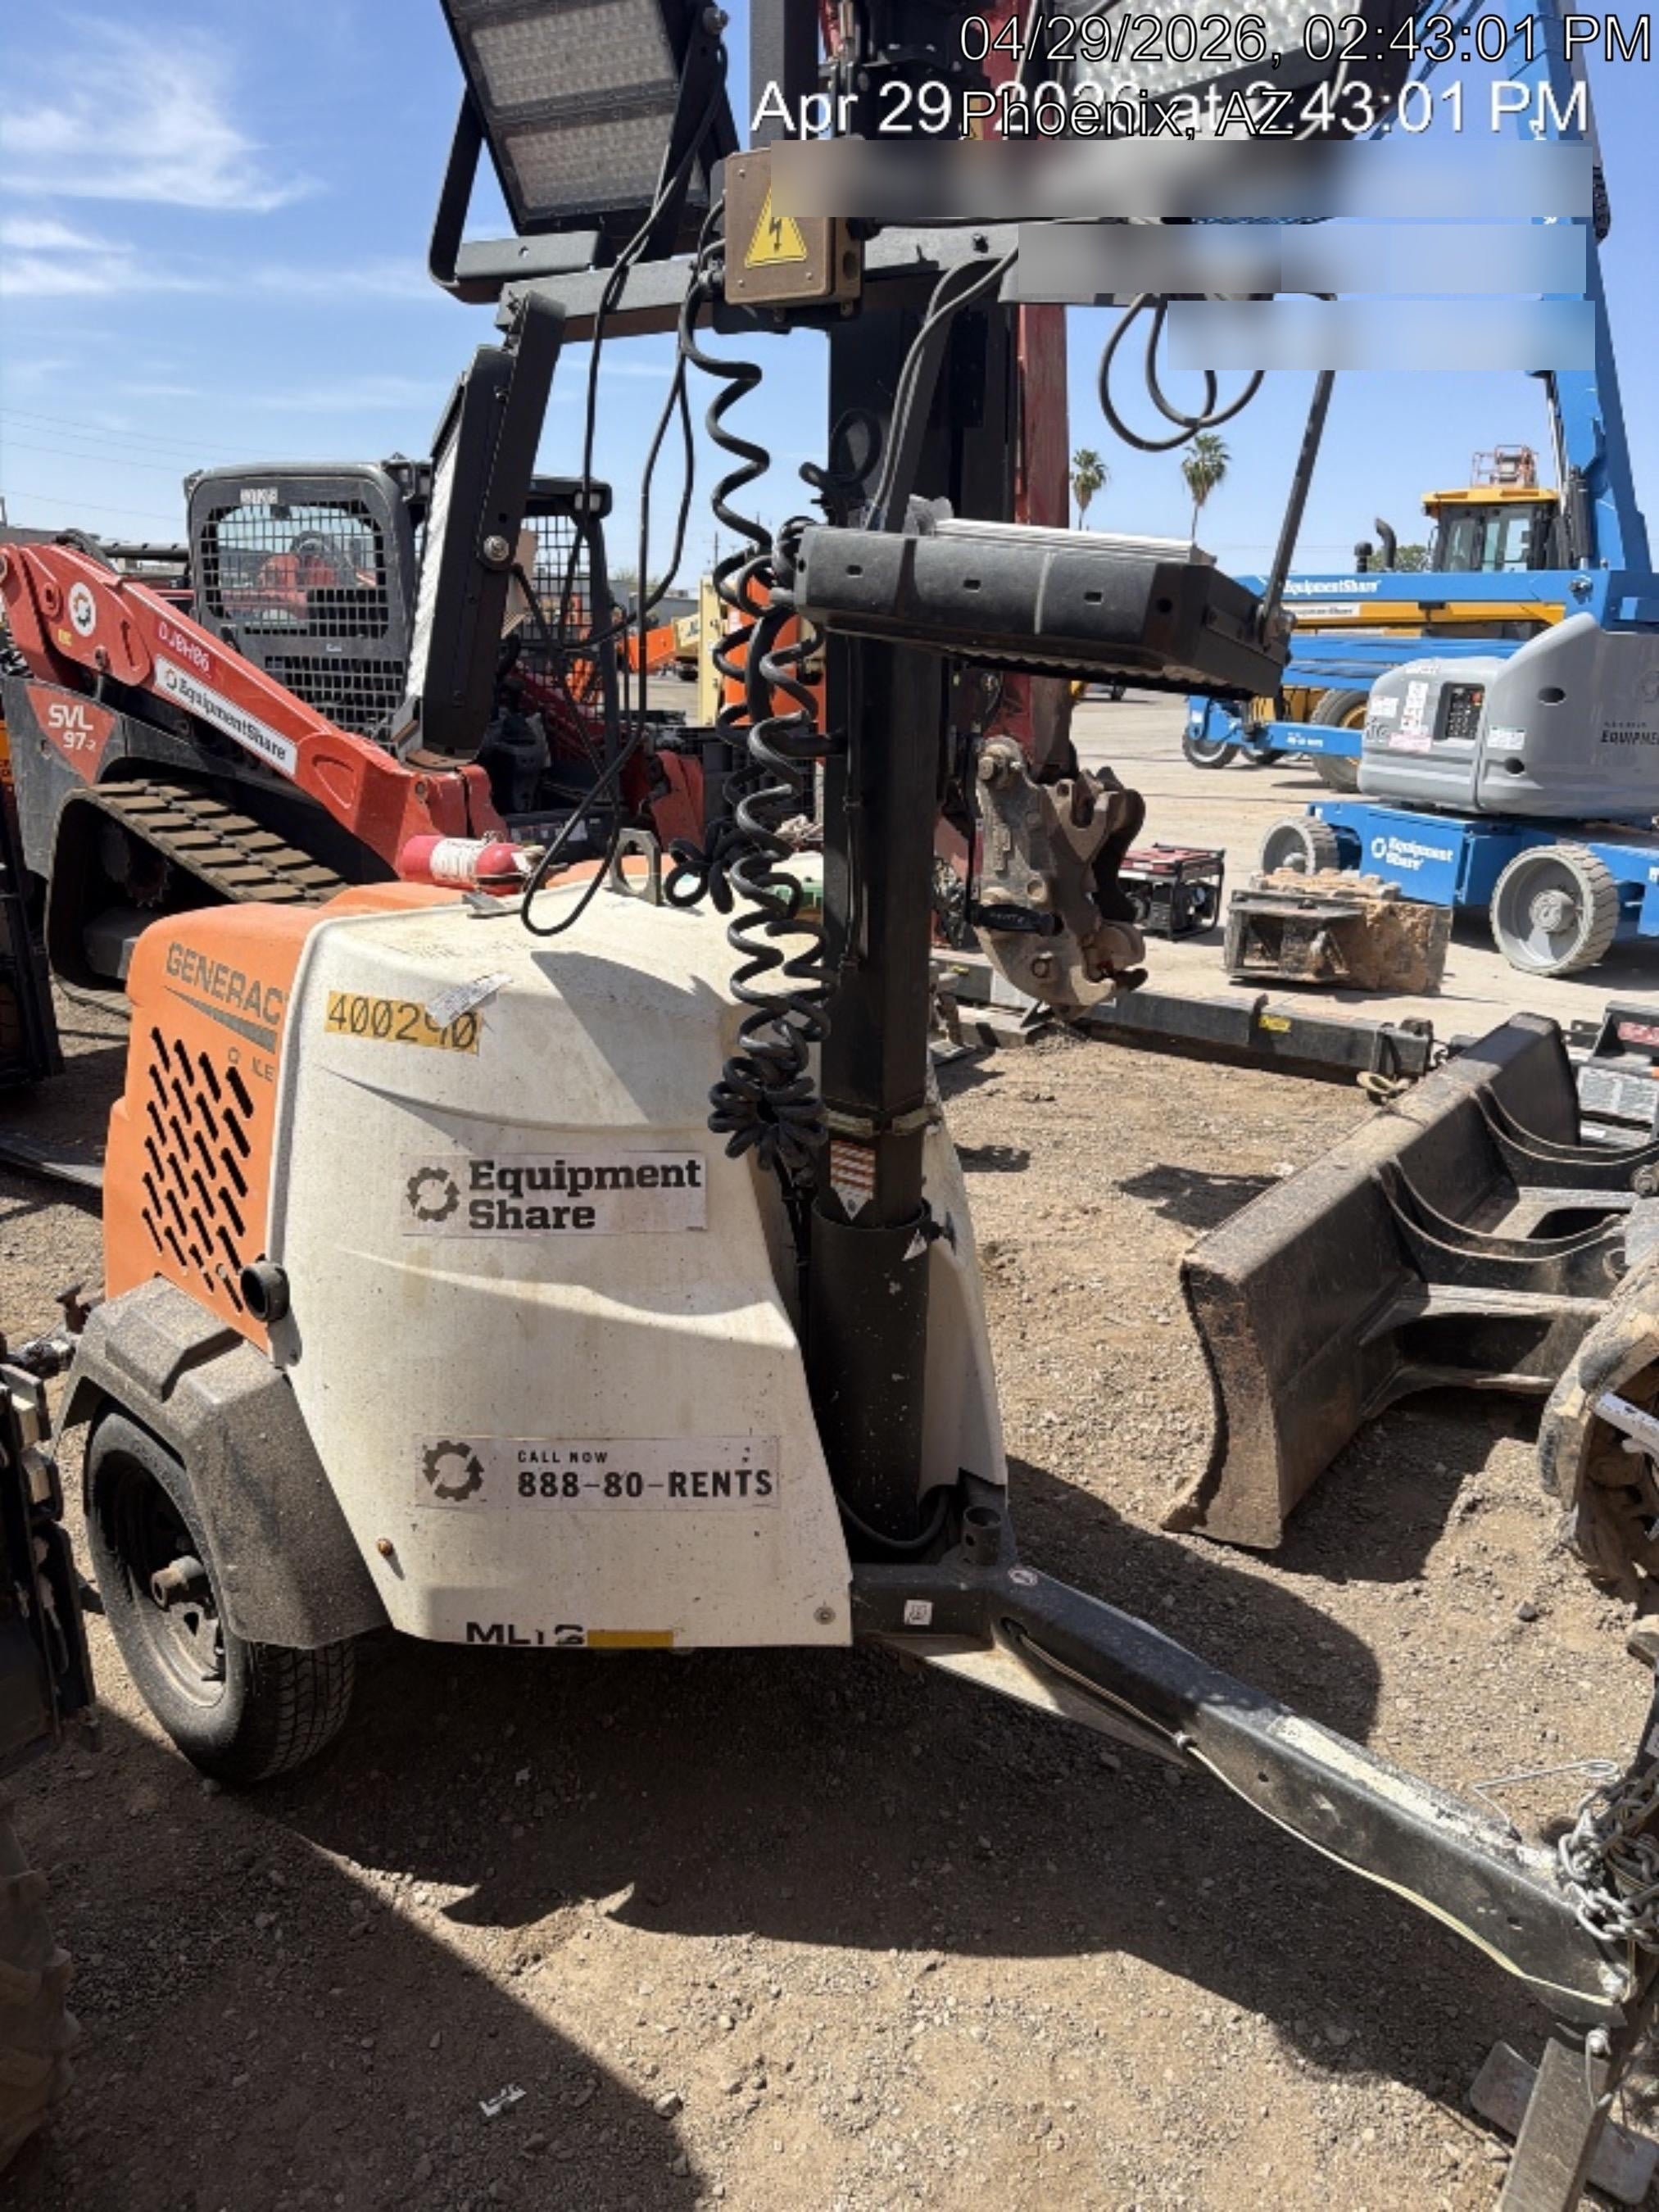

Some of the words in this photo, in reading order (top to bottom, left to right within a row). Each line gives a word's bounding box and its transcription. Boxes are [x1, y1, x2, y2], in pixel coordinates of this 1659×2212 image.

[48, 703, 94, 732] SVL
[166, 941, 283, 1025] GENERAC
[469, 1159, 702, 1199] Equipment
[469, 1199, 596, 1230] Share
[517, 1449, 561, 1464] CALL
[569, 1450, 609, 1464] NOW
[517, 1469, 773, 1498] 888-80-RENTS
